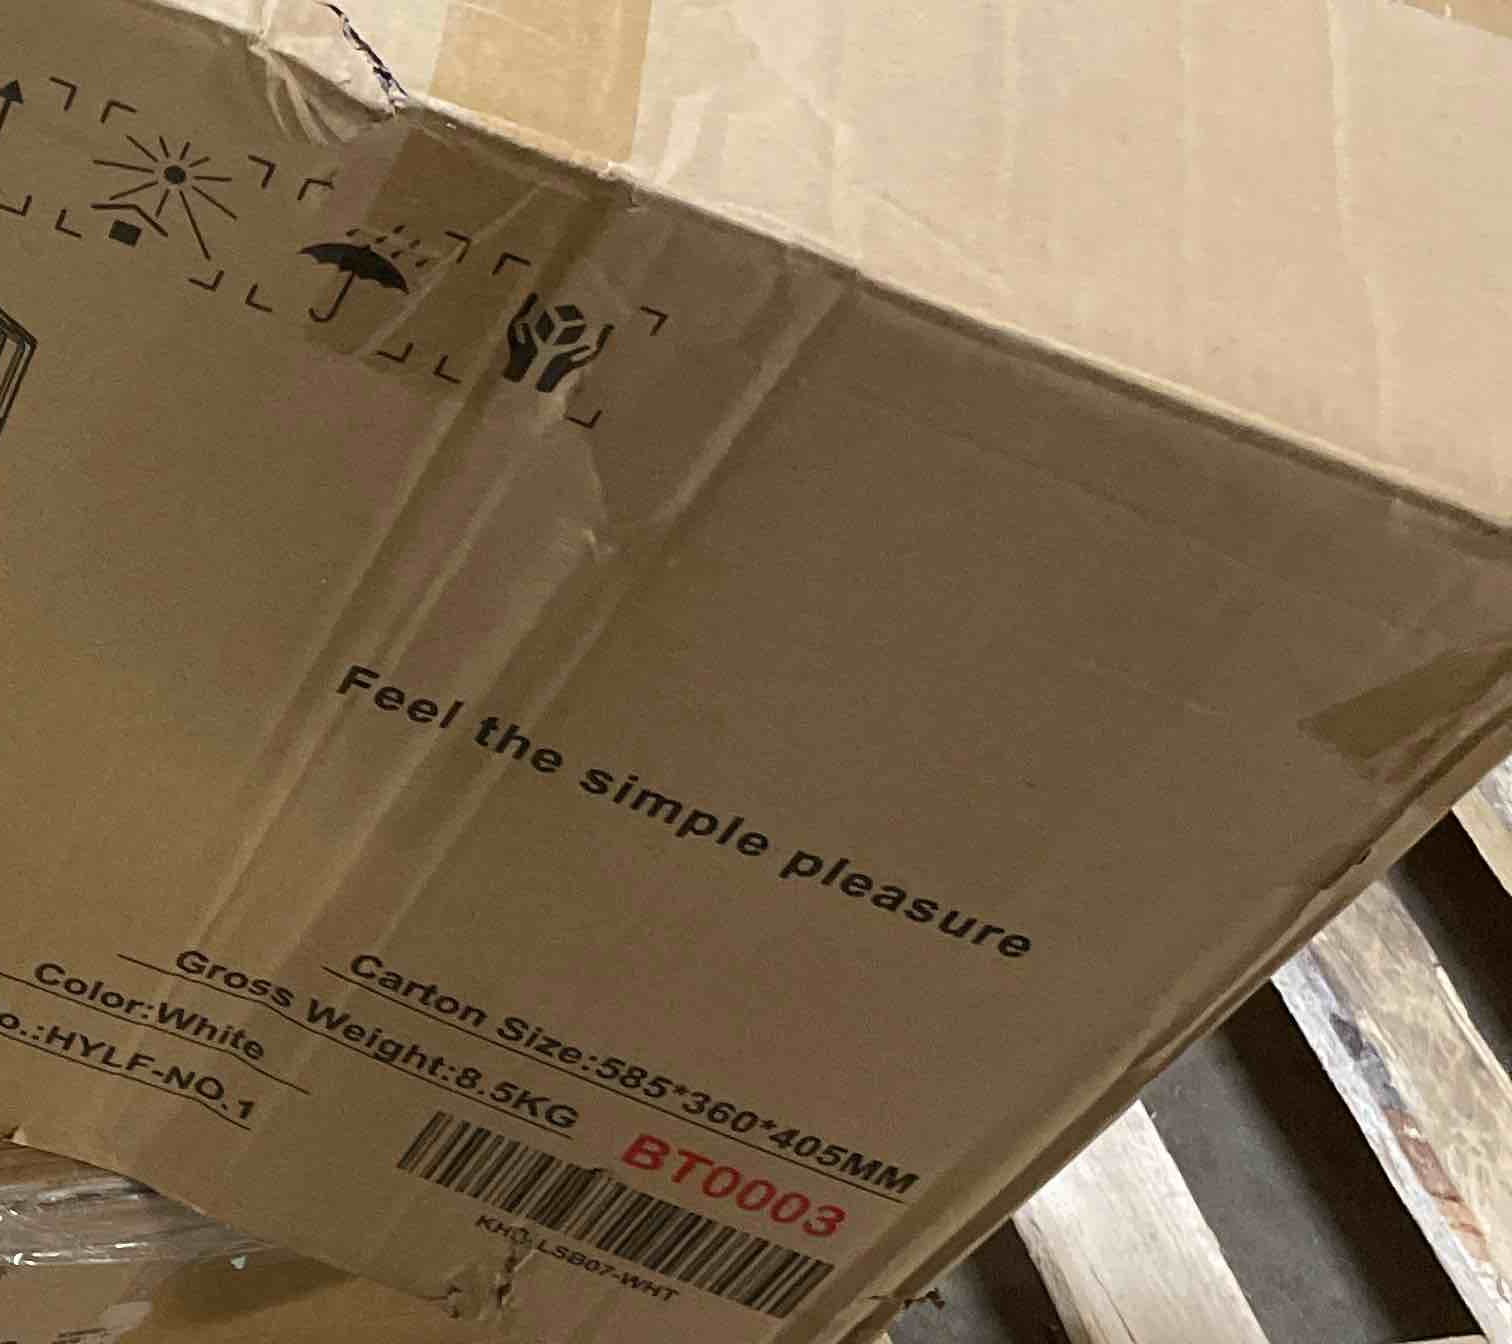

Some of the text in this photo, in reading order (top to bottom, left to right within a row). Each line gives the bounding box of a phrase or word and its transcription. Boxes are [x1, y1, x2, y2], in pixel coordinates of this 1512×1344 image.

[336, 664, 1033, 959] Feel the simple pleasure
[33, 962, 266, 1061] Color:White
[175, 949, 579, 1129] Gross Weight:8.5KG
[349, 953, 489, 1028] Carton
[619, 1132, 848, 1240] BT0003
[474, 1215, 680, 1302] KHDLSB07-WHT
